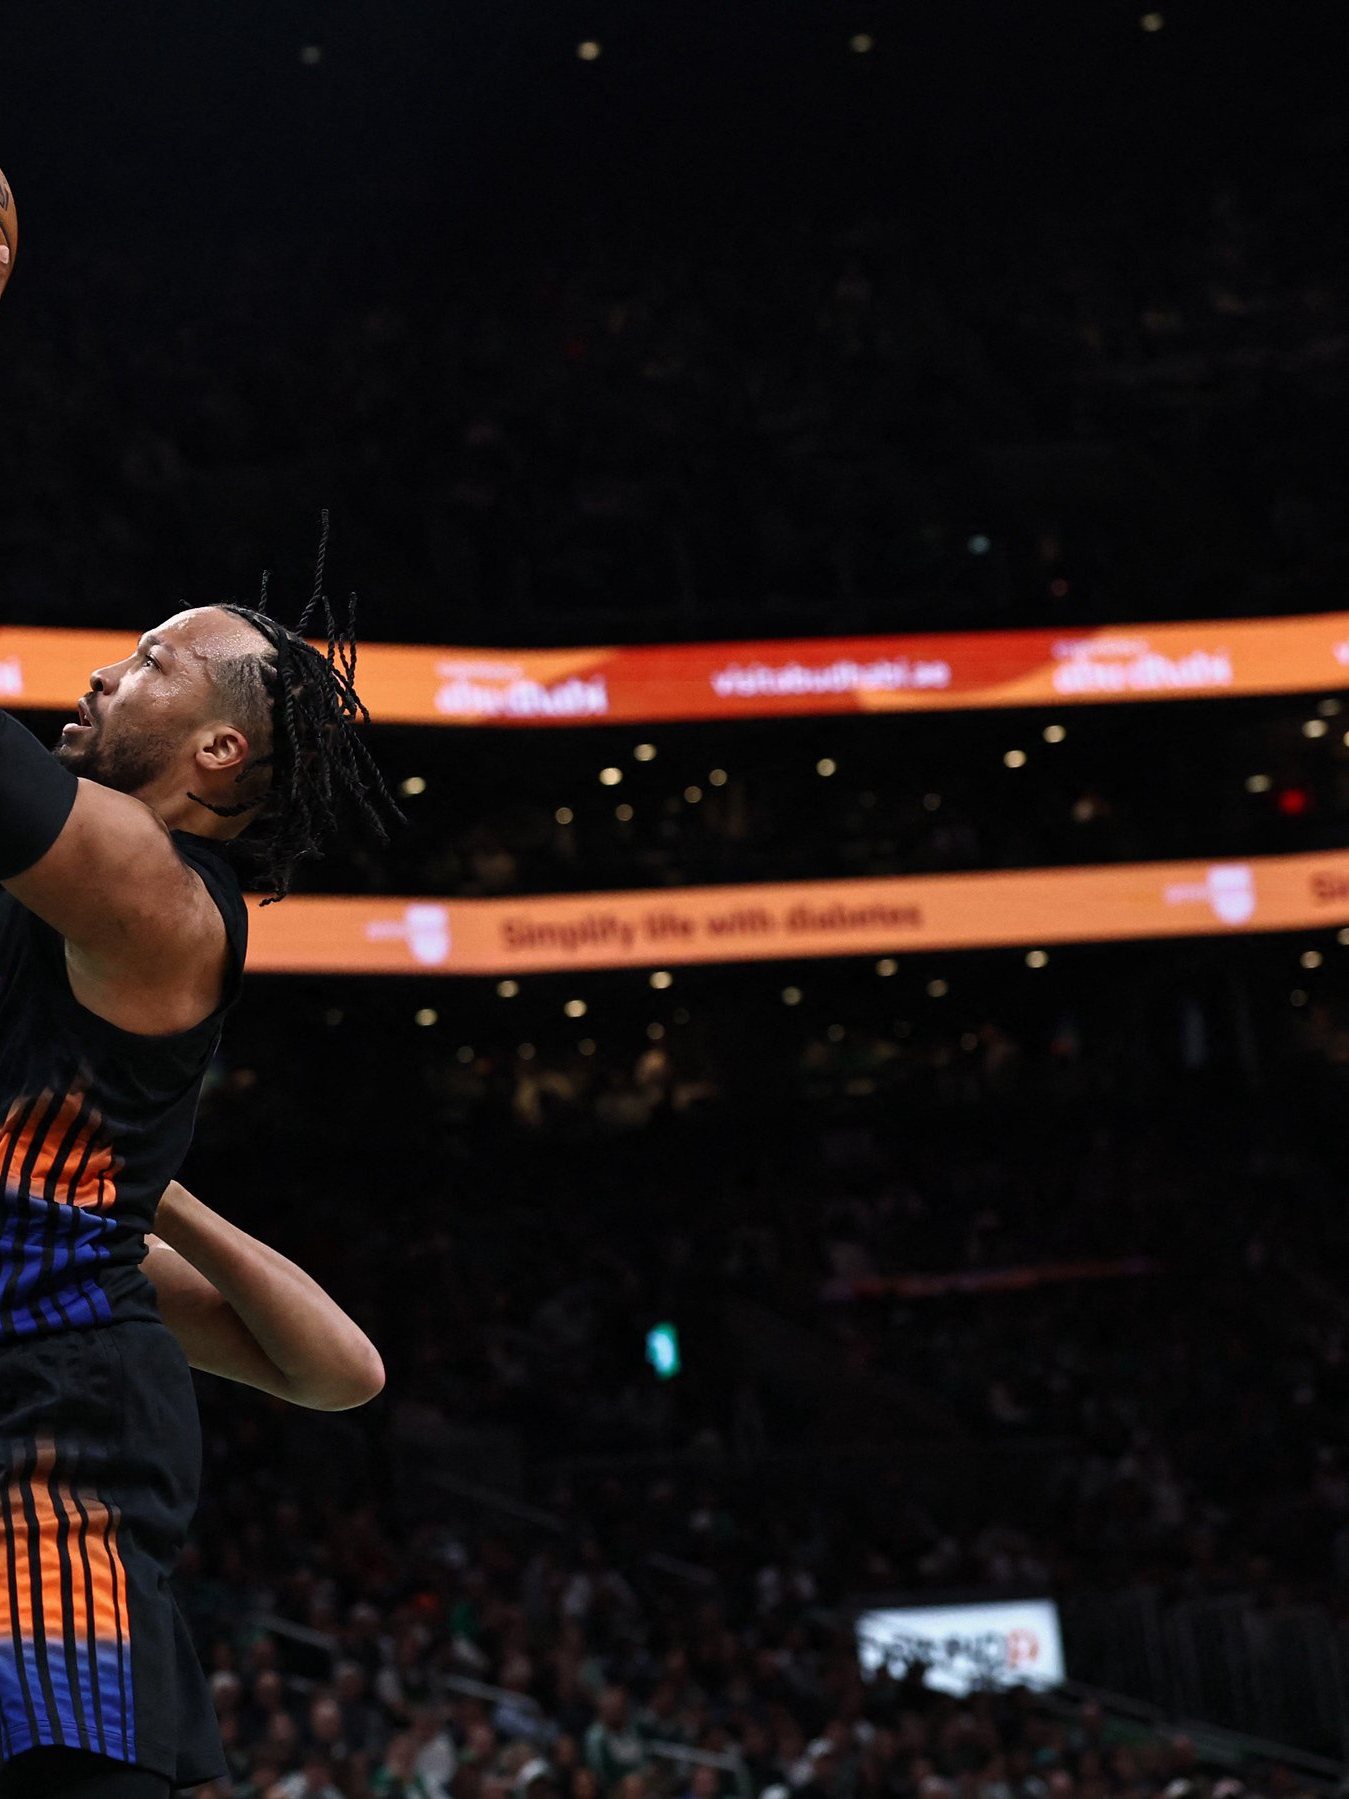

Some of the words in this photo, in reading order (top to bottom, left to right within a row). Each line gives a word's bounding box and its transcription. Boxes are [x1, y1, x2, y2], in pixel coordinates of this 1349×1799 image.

[1311, 871, 1349, 908] Si
[504, 914, 635, 953] Simplify
[645, 910, 694, 943] life
[708, 903, 776, 937] with
[786, 900, 924, 934] diabetes
